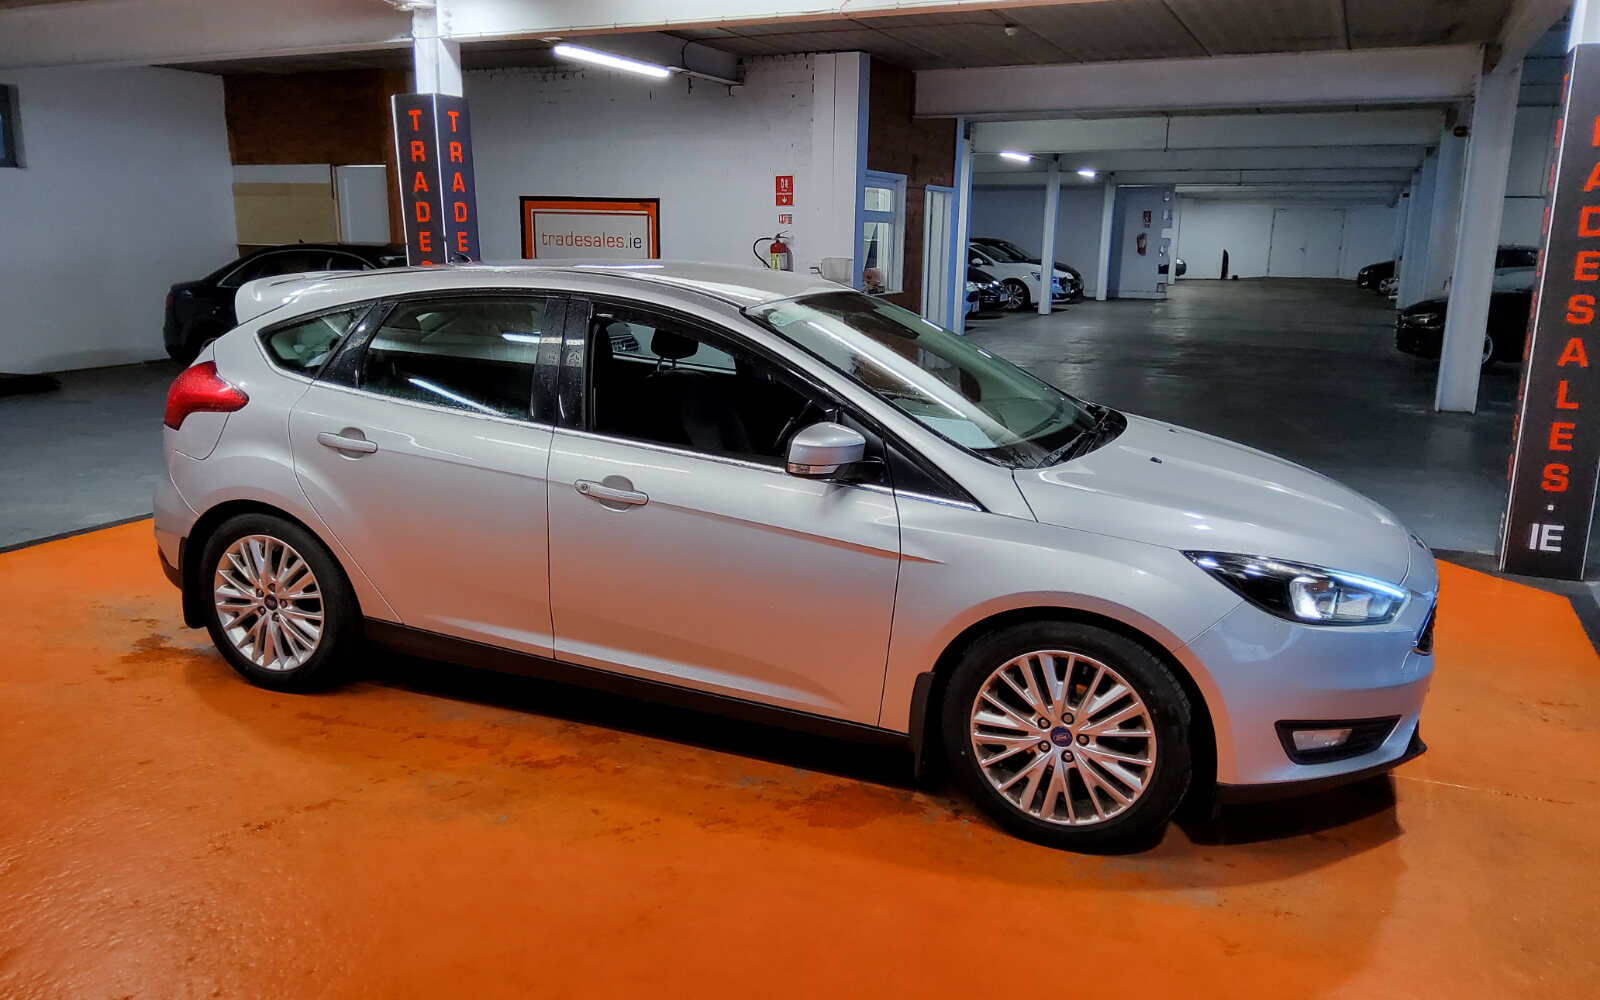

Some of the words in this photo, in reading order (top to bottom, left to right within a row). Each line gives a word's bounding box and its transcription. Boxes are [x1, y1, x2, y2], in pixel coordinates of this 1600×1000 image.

[408, 109, 433, 266] TRADE
[447, 110, 469, 252] TRADE
[541, 231, 642, 249] tradesales.ie
